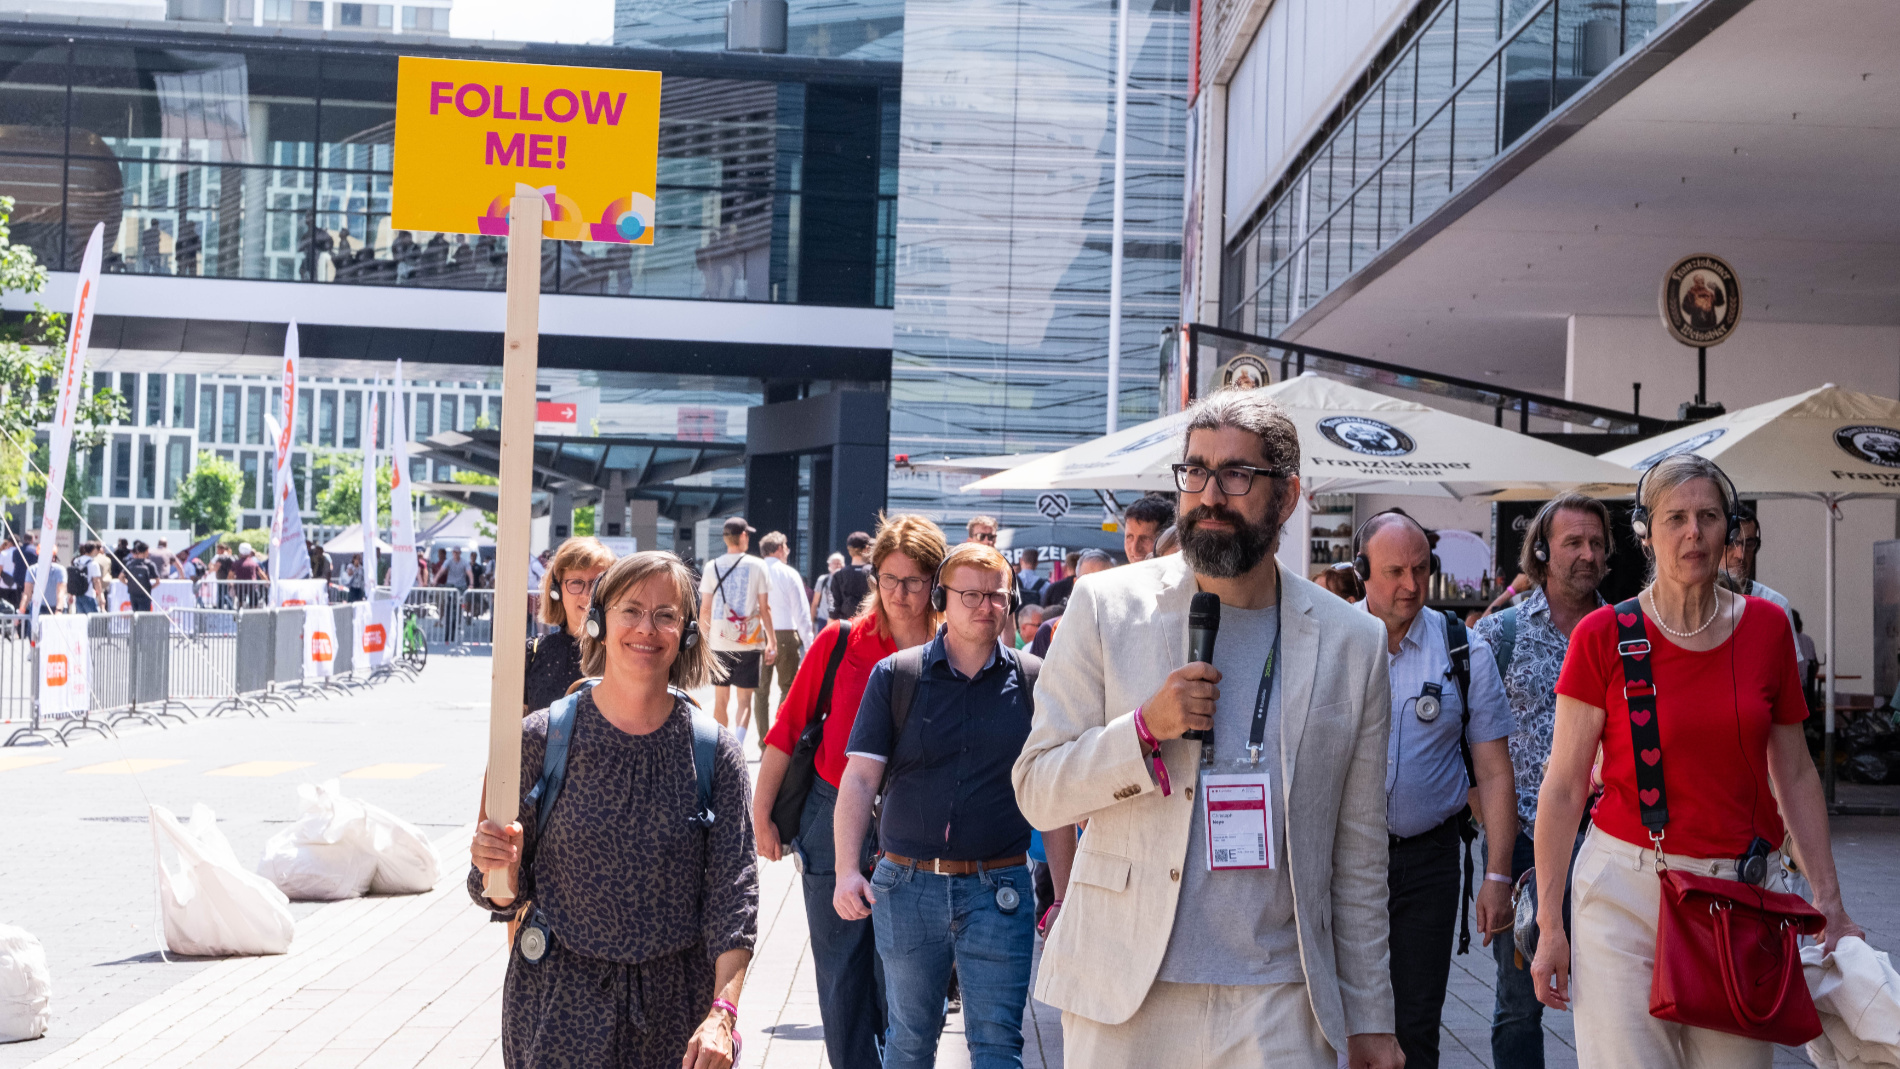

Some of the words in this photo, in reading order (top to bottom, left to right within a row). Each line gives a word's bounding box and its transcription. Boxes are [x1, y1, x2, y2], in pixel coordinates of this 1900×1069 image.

[429, 81, 628, 126] FOLLOW
[484, 131, 567, 170] ME!
[1311, 456, 1472, 470] Franziskaner
[1358, 468, 1444, 477] WEISSBIER
[1830, 470, 1900, 480] Franz
